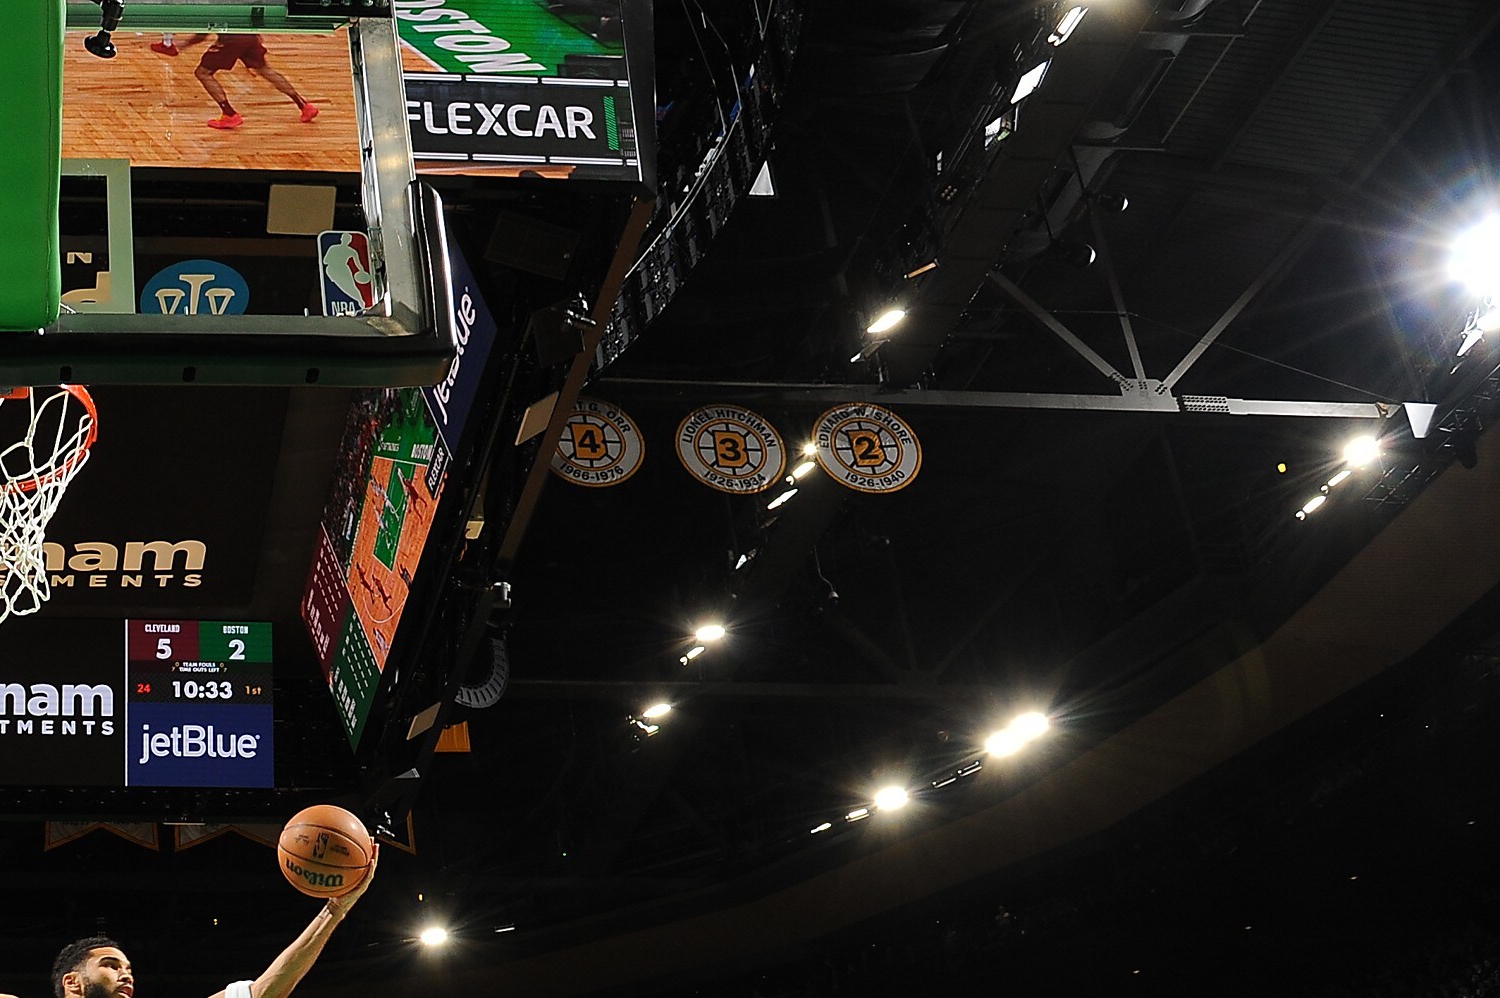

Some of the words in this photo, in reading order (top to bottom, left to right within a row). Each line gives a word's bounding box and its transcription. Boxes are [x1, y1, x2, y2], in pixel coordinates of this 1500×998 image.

[607, 411, 631, 433] ORR
[682, 410, 714, 443] LIONEL
[715, 408, 776, 447] HITCHMAN
[819, 410, 850, 448] EDWARD
[854, 408, 871, 418] W.
[873, 409, 912, 446] SHORE
[578, 429, 600, 453] 4
[719, 438, 741, 461] 3
[855, 436, 880, 460] 2
[559, 463, 624, 483] 1966-1976
[704, 471, 766, 489] 1925-1934
[844, 470, 906, 488] 1926-1940
[145, 624, 180, 633] CLEVELAND
[222, 626, 249, 634] BOSTON
[156, 638, 172, 660] 5
[228, 639, 246, 661] 2
[137, 684, 151, 693] 24
[172, 681, 233, 699] 10:33
[139, 724, 259, 765] jetBlue
[286, 857, 344, 887] Wilson
